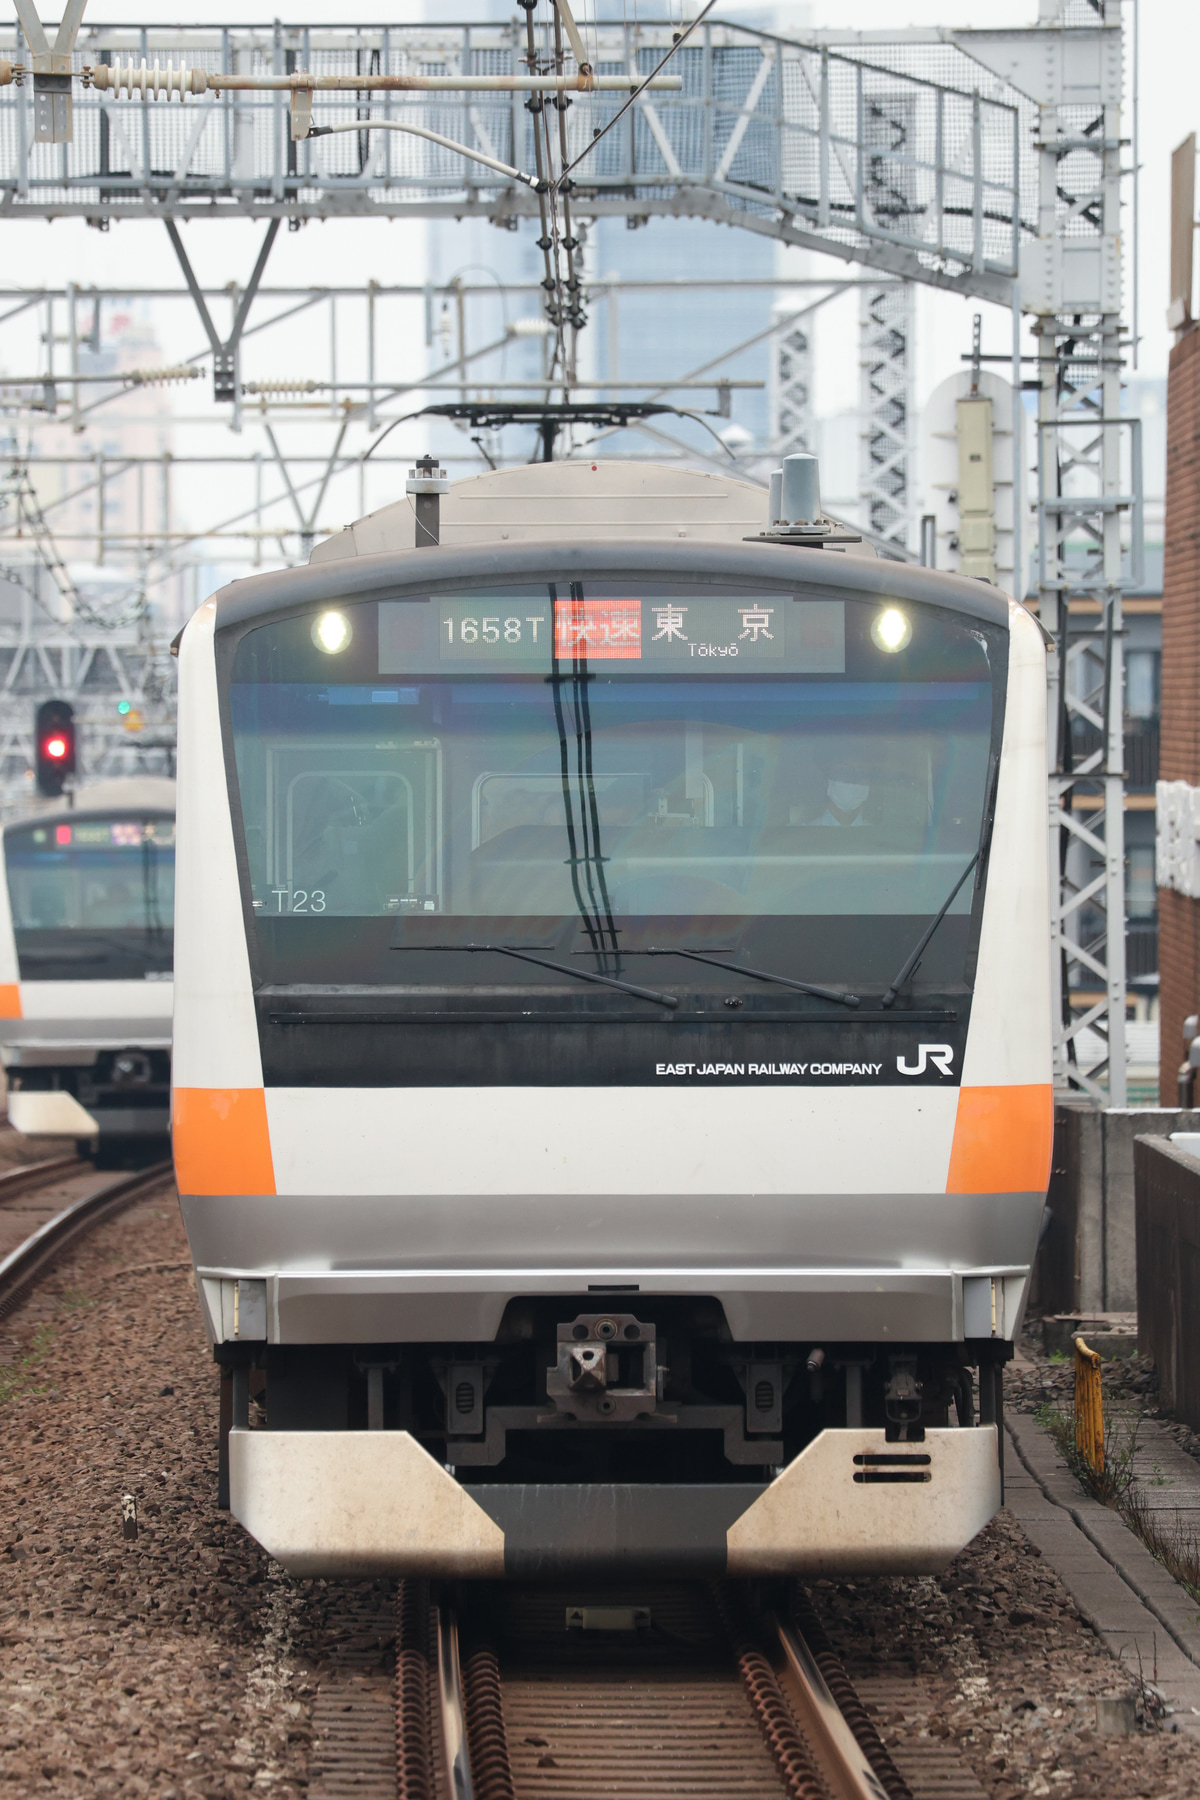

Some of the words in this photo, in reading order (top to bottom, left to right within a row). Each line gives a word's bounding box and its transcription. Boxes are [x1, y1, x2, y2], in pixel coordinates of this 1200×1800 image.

[443, 616, 545, 644] 1658T
[555, 607, 640, 646] 快速
[652, 603, 774, 643] 東京
[687, 642, 739, 657] Tōkyō
[271, 890, 326, 912] T23
[655, 1063, 696, 1075] EAST
[696, 1063, 745, 1075] JAPAN
[748, 1063, 808, 1075] RAILWAY
[810, 1063, 883, 1075] COMPANY
[896, 1043, 954, 1076] JR
